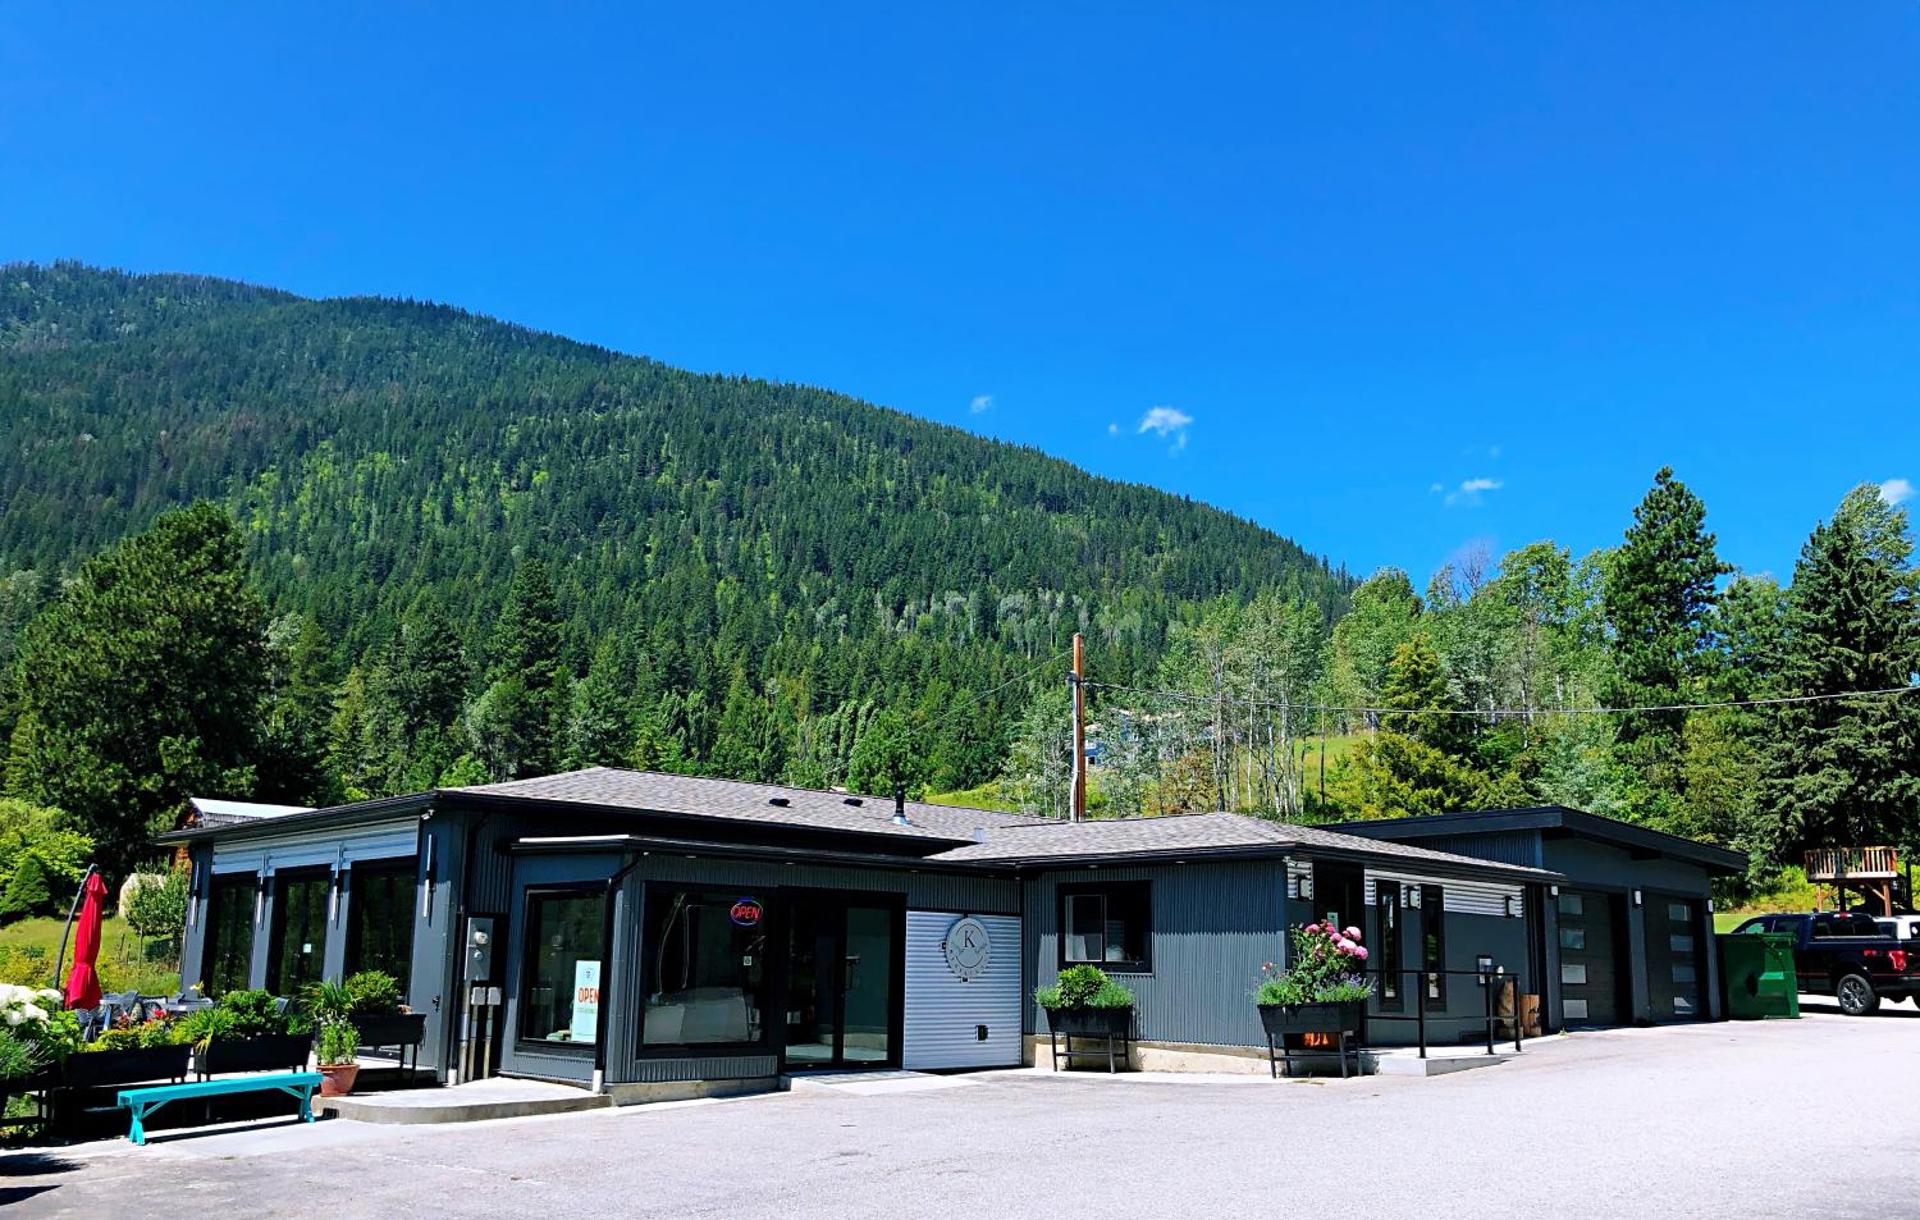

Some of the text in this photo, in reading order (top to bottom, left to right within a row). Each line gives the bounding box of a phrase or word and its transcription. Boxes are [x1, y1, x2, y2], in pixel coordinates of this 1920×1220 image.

[732, 905, 760, 919] OPEN
[964, 930, 975, 948] K
[578, 987, 599, 1004] OPEN
